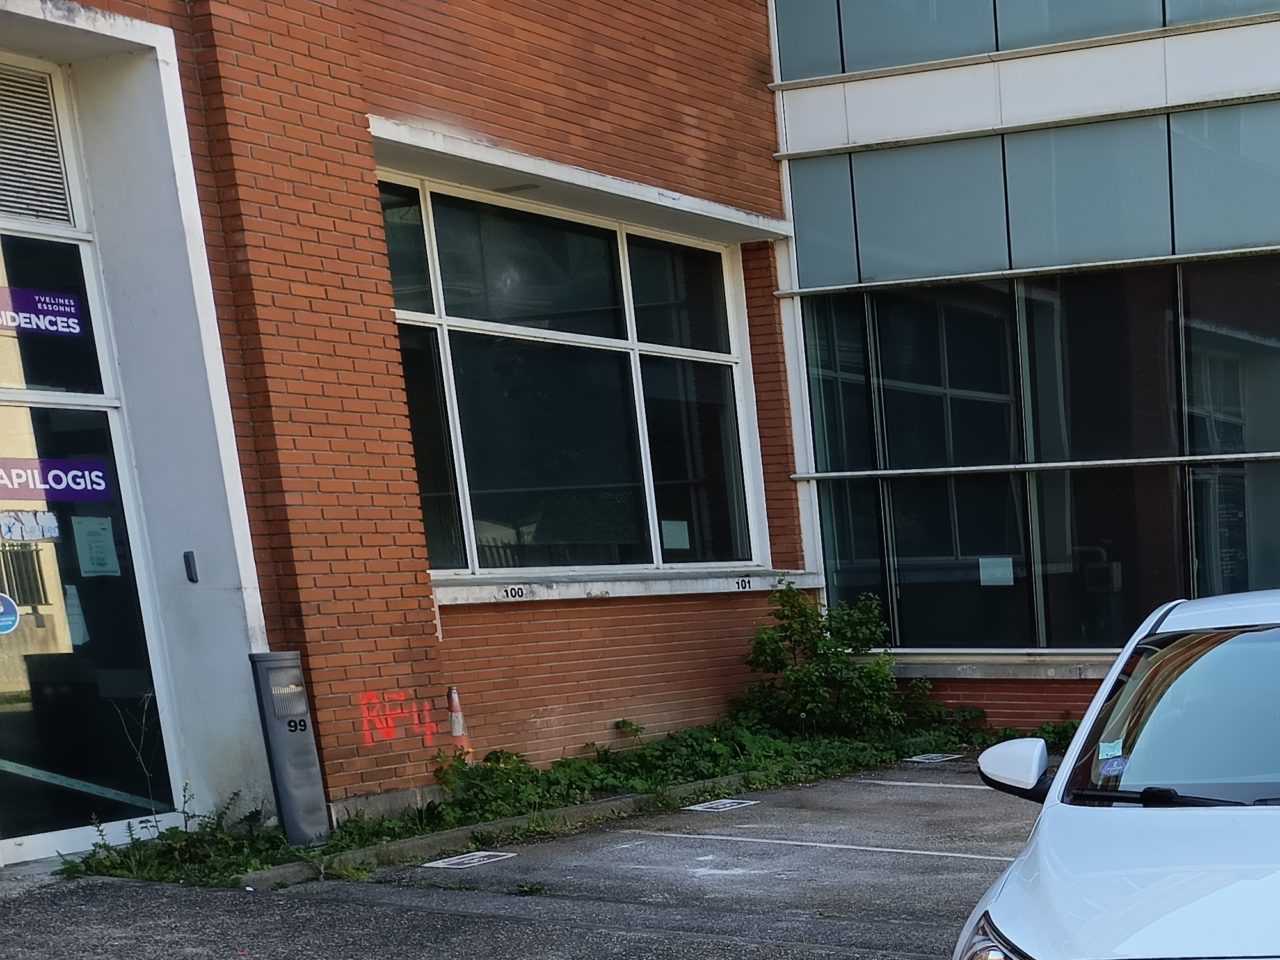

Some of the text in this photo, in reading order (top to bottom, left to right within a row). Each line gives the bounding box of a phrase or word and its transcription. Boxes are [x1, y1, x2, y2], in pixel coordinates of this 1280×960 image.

[34, 295, 75, 306] YVELINES
[37, 303, 76, 313] ESSONNE
[0, 311, 81, 334] IDENCES
[736, 579, 751, 590] 101
[504, 587, 524, 598] 100
[287, 719, 307, 732] 99
